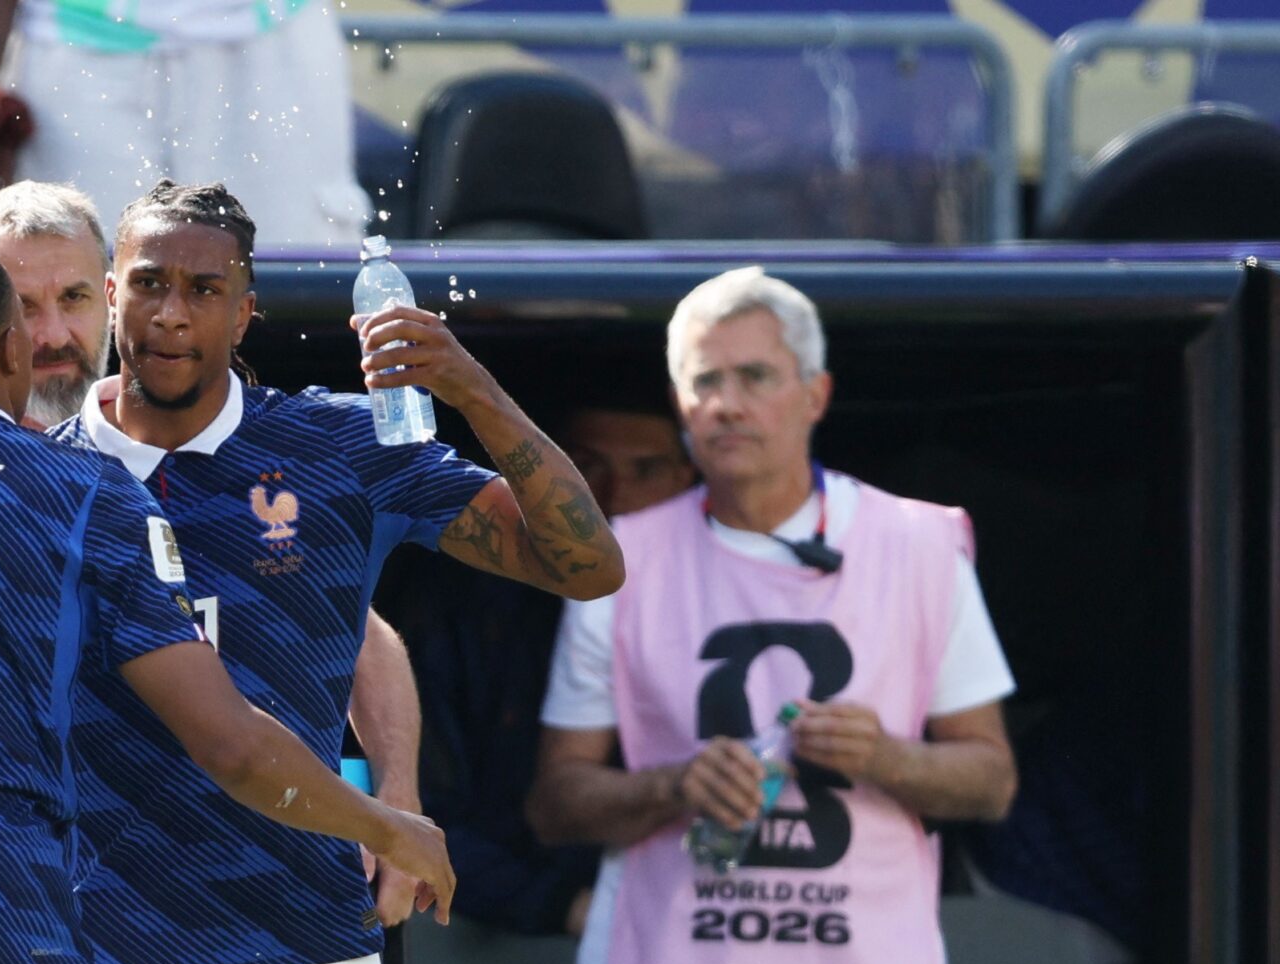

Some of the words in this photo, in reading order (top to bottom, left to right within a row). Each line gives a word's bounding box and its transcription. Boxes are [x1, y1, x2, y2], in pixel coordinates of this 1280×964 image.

[758, 819, 817, 851] IFA
[694, 880, 794, 902] WORLD
[800, 882, 851, 905] CUP
[692, 909, 851, 945] 2026
